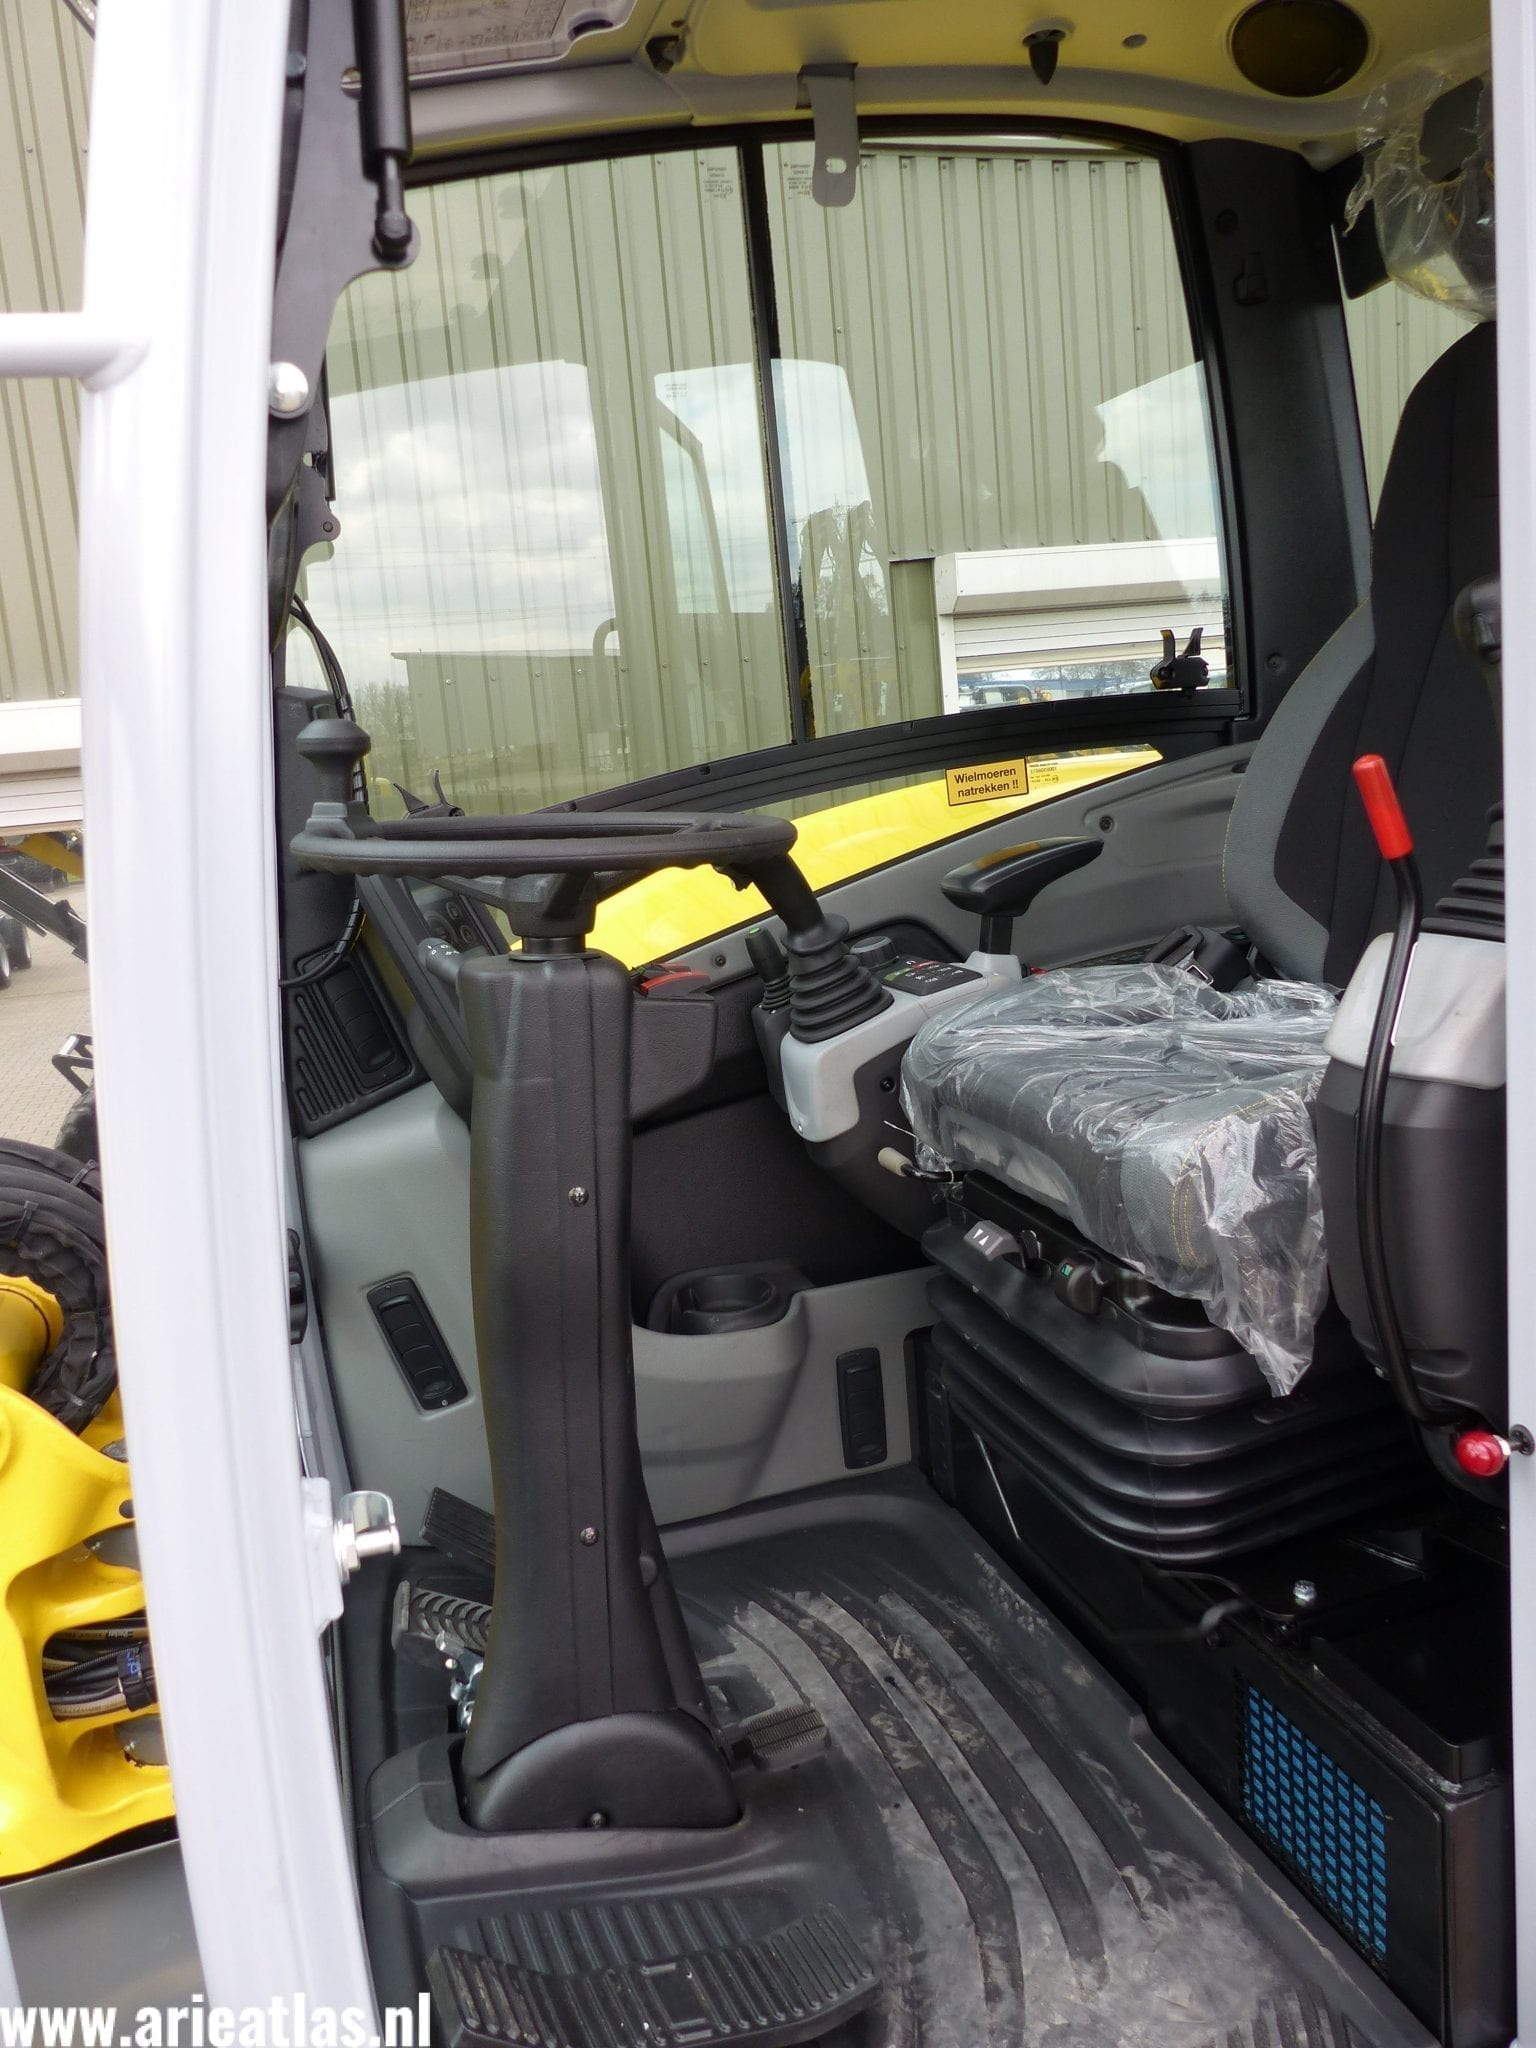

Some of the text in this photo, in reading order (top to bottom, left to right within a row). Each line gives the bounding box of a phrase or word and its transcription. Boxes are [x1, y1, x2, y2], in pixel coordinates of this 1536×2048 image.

[954, 768, 1016, 784] Wielmoeren
[958, 782, 1010, 798] natrekken
[1012, 779, 1019, 789] !!
